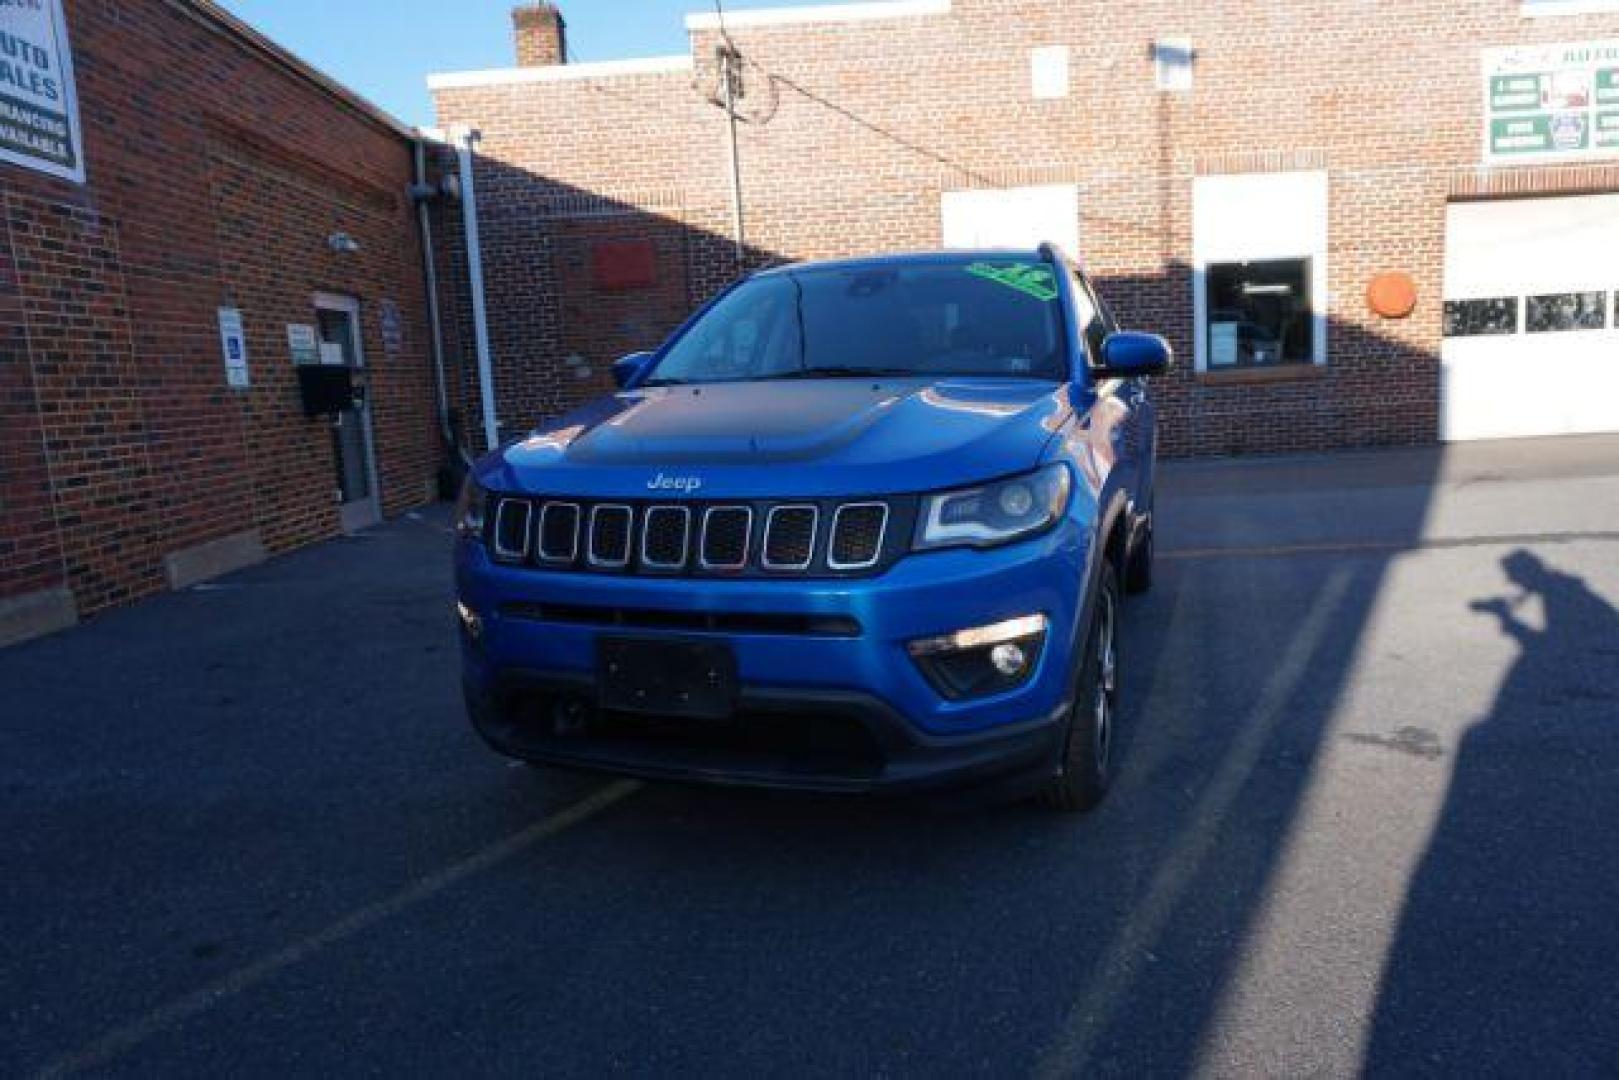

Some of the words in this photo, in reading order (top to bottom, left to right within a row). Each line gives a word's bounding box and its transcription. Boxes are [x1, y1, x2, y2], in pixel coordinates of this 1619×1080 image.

[0, 29, 49, 69] UTO
[0, 59, 59, 101] ALES
[646, 472, 702, 494] Jeep
